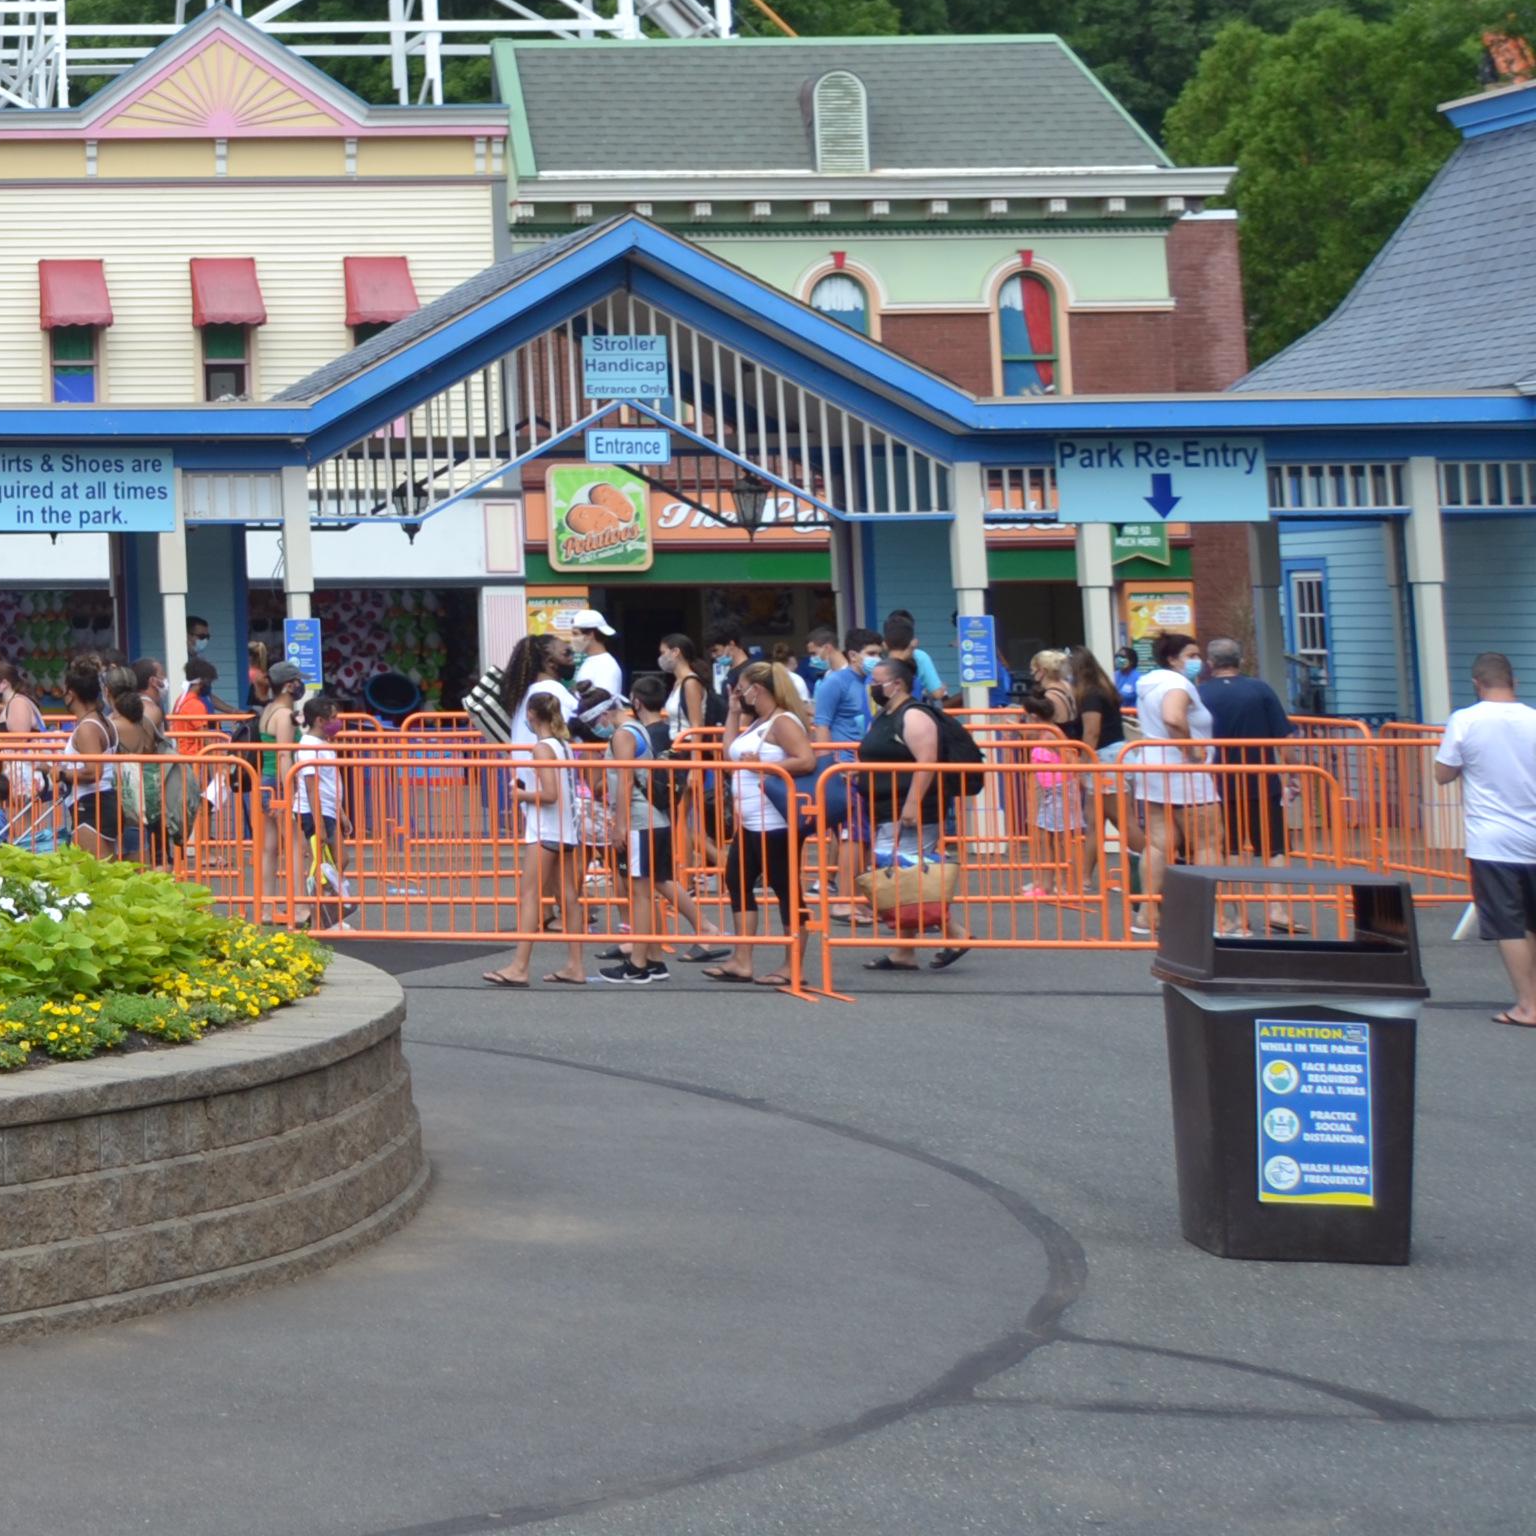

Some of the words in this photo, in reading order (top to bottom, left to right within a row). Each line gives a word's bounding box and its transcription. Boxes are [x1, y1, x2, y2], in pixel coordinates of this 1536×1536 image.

[592, 337, 656, 352] Stroller
[585, 358, 666, 375] Handicap
[586, 384, 637, 394] Entrance
[640, 384, 666, 395] Only
[594, 436, 661, 455] Entrance
[40, 453, 54, 473] &
[61, 454, 124, 473] Shoes
[131, 458, 162, 473] are
[1059, 441, 1124, 469] Park
[1134, 440, 1258, 475] Re-Entry
[60, 483, 79, 500] at
[85, 481, 107, 500] all
[113, 480, 168, 500] times
[16, 505, 34, 524] in
[41, 505, 72, 524] the
[79, 505, 128, 528] park.
[1260, 1025, 1344, 1039] ATTENTION
[1260, 1042, 1293, 1053] WHILE
[1294, 1043, 1308, 1053] IN
[1309, 1043, 1328, 1054] THE
[1301, 1062, 1326, 1072] FACE
[1328, 1063, 1363, 1073] MASKS
[1307, 1073, 1358, 1084] REQUIRED
[1299, 1084, 1313, 1094] AT
[1315, 1085, 1335, 1095] ALL
[1336, 1086, 1366, 1096] TIMES
[1309, 1110, 1357, 1121] PRACTICE
[1314, 1122, 1353, 1133] SOCIAL
[1302, 1132, 1366, 1144] DISTANCING
[1299, 1163, 1330, 1173] WASH
[1332, 1164, 1369, 1175] HANDS
[1303, 1174, 1366, 1185] FREQUENTLY
